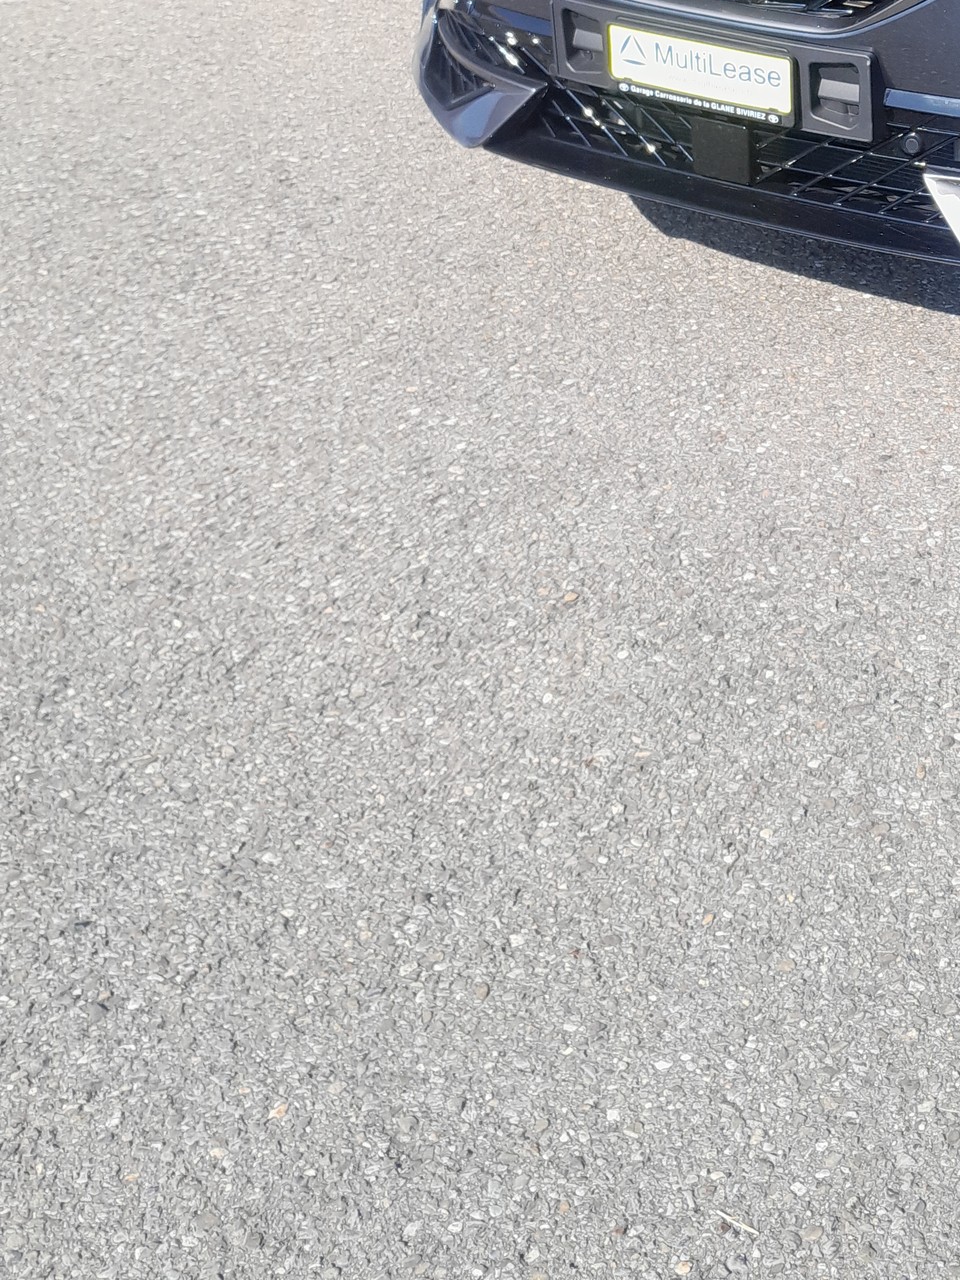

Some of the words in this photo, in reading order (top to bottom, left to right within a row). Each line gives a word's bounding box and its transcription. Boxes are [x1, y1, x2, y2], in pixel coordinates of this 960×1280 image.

[655, 42, 781, 88] MultiLease
[630, 85, 654, 97] Garage
[654, 90, 692, 105] Carrosserie
[693, 98, 702, 107] de
[735, 106, 767, 120] SIVIRIEZ
